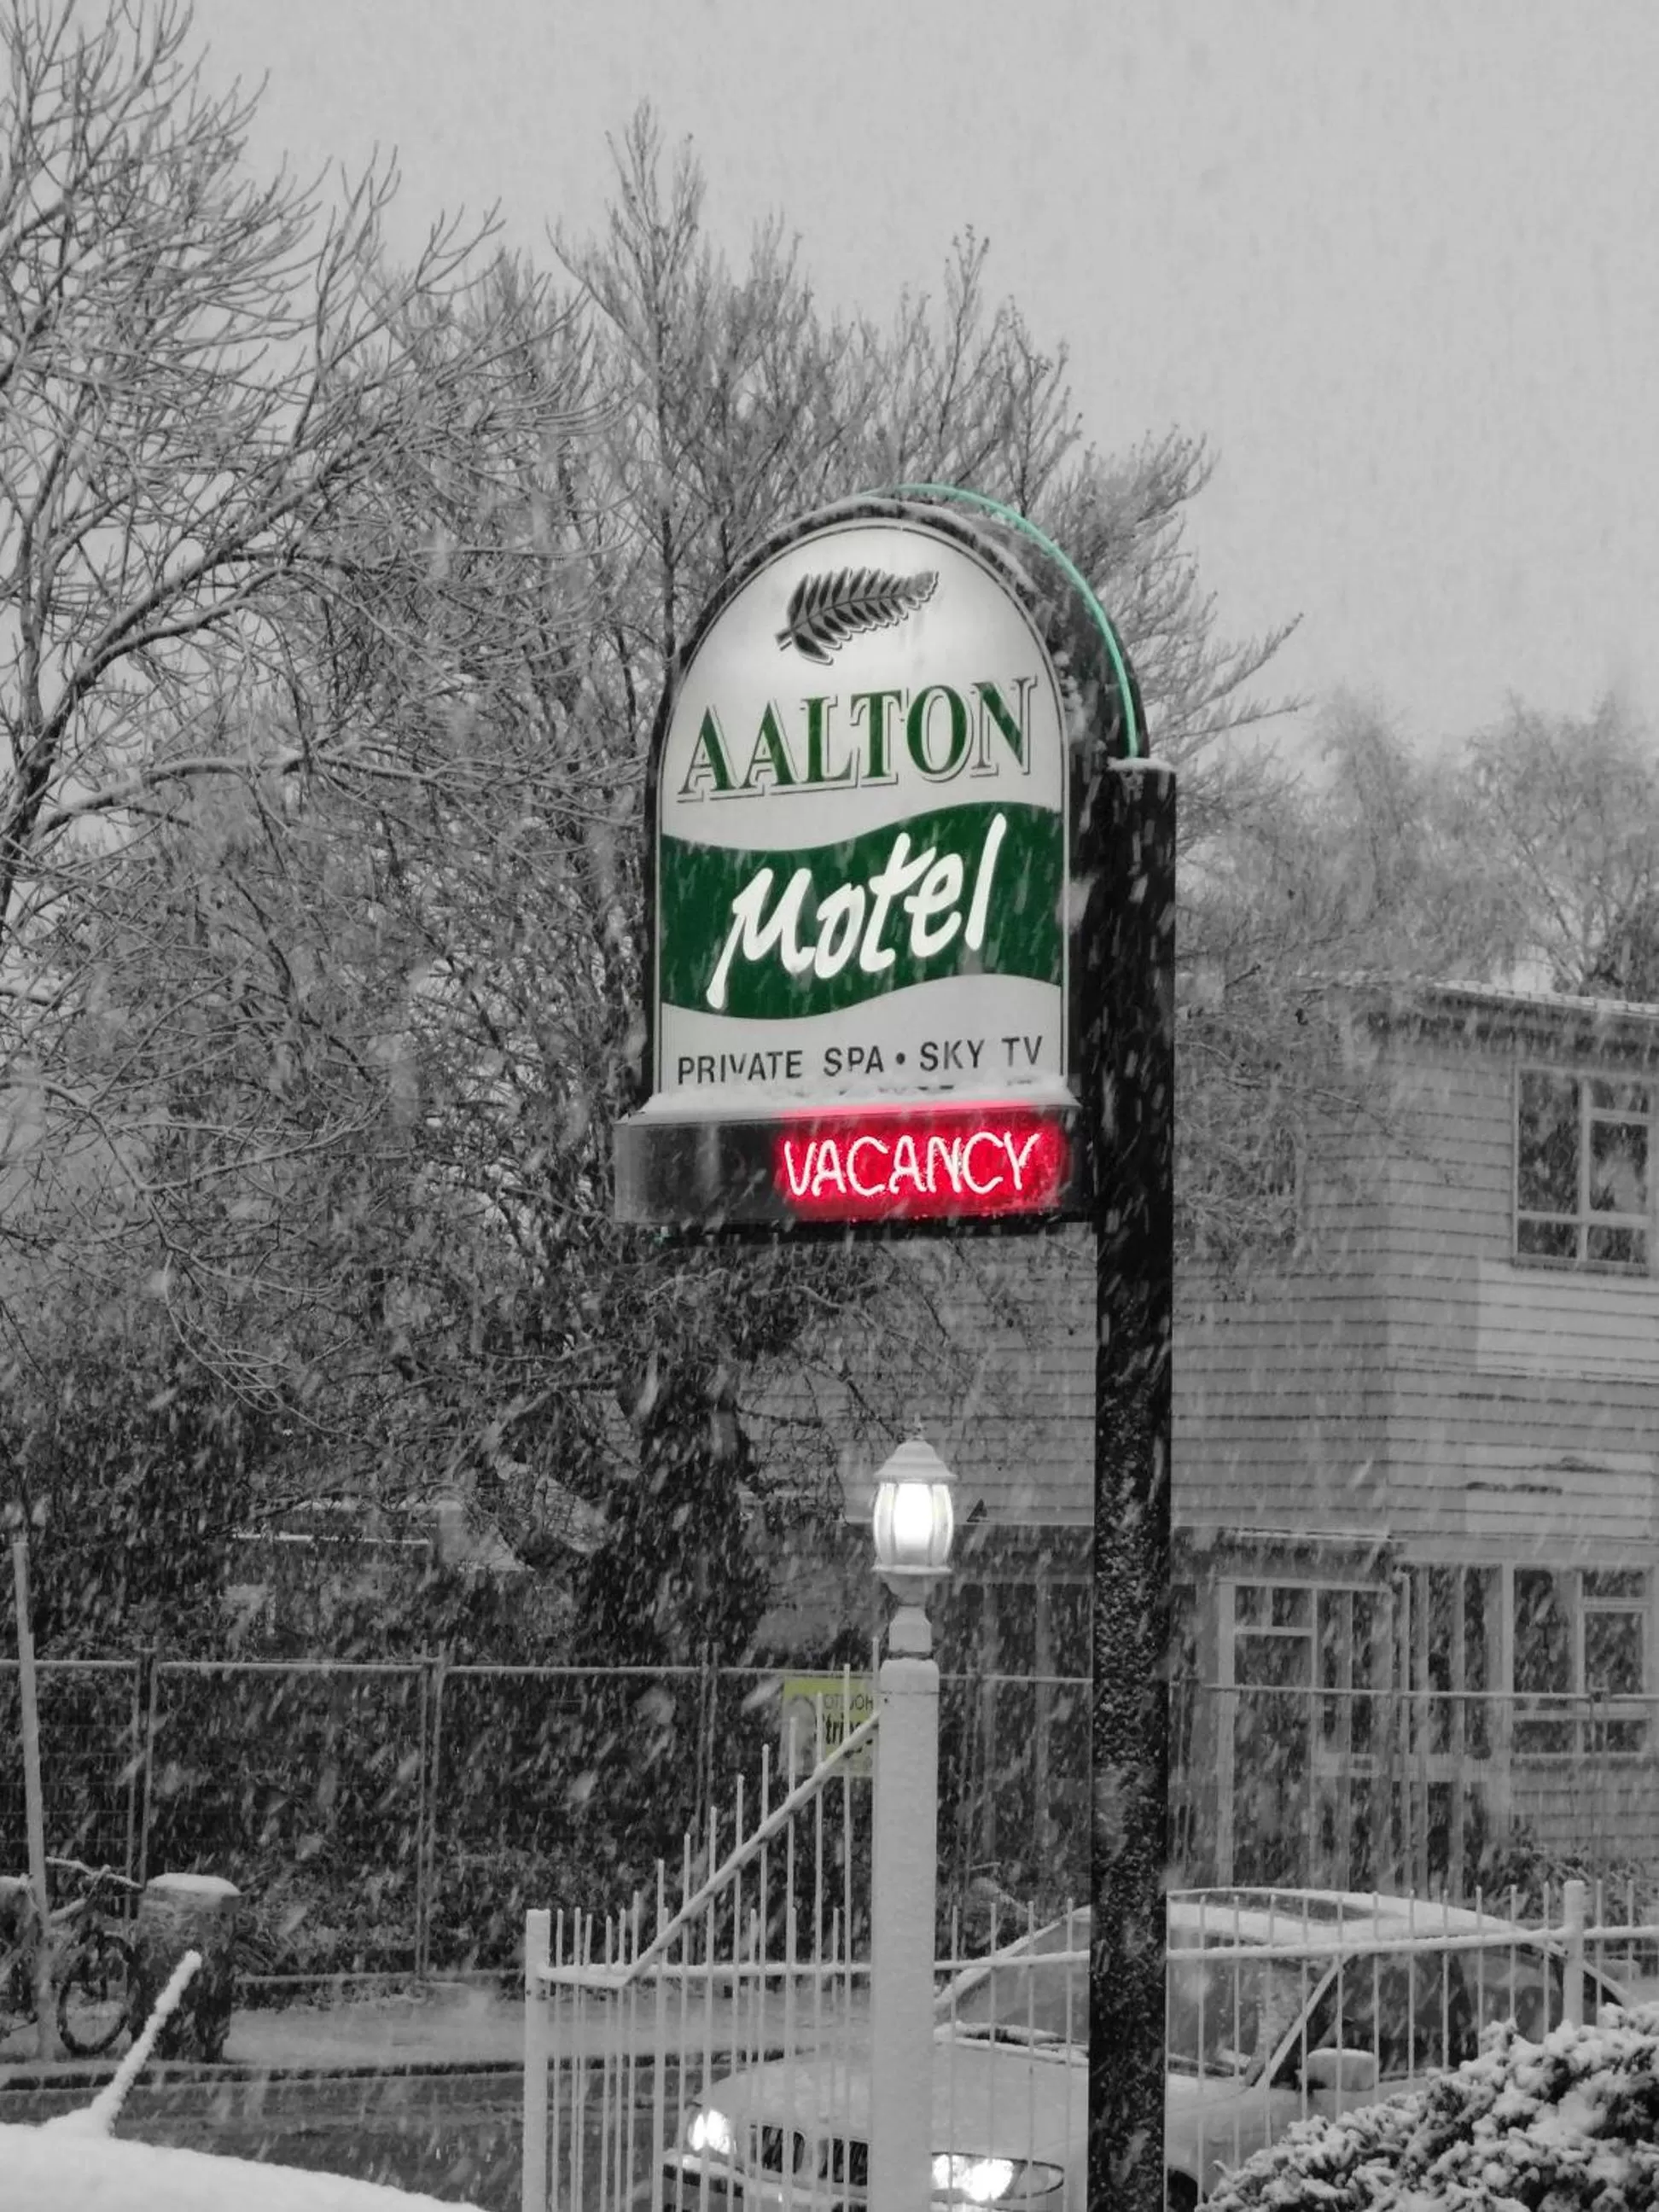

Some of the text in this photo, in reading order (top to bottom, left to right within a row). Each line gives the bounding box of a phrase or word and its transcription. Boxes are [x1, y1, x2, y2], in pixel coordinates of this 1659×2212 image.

[677, 676, 1037, 801] AALTON
[707, 812, 1007, 1009] Motel
[678, 1035, 1044, 1085] PRIVATE SPA SKY TV
[783, 1132, 1040, 1196] VACANCY
